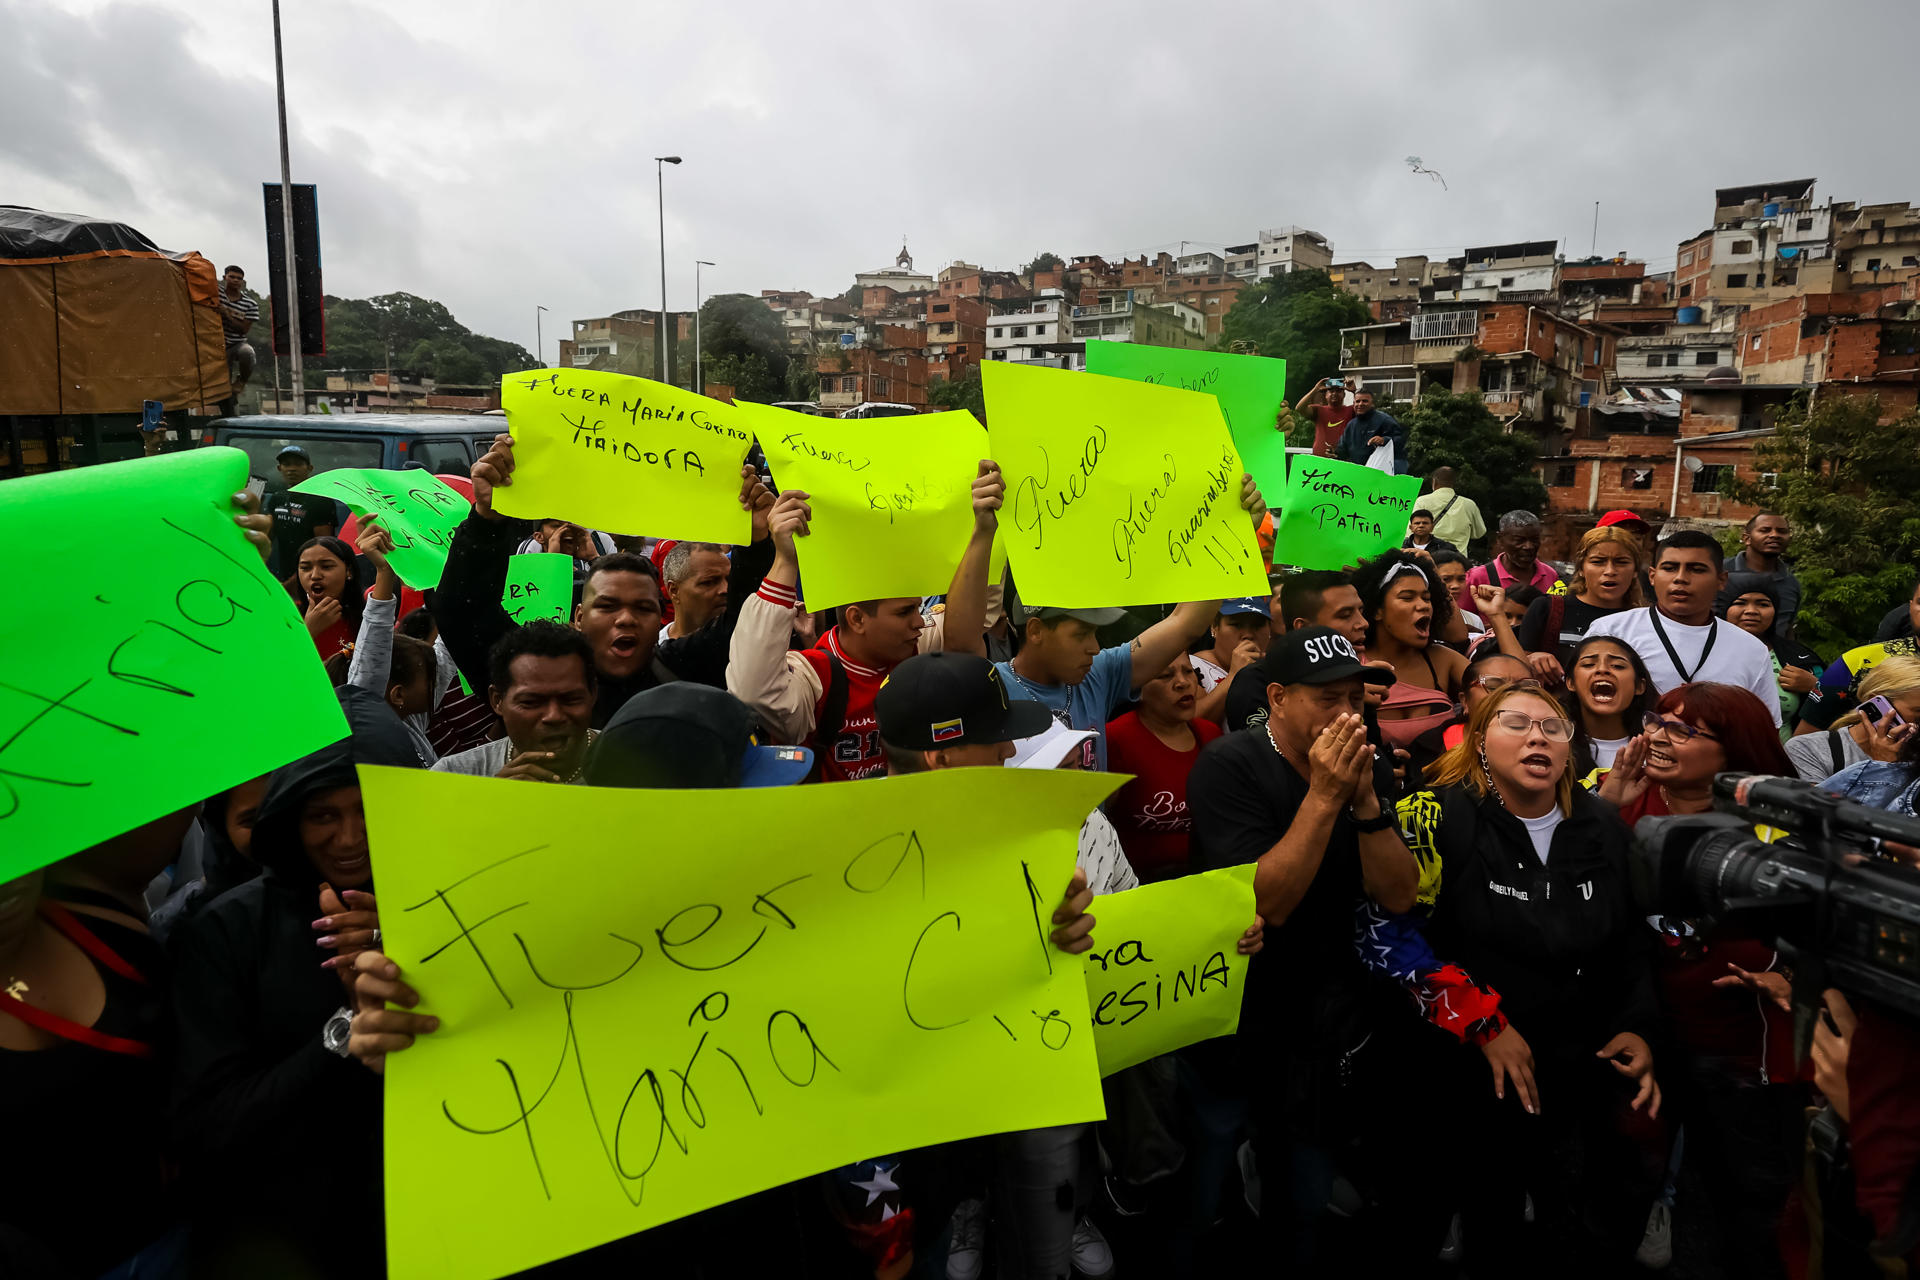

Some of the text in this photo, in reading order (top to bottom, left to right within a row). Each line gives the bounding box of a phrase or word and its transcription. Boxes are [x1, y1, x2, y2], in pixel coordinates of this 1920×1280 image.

[1015, 424, 1107, 550] Fuera
[1113, 453, 1177, 580] Fuera
[834, 729, 882, 762] 21
[403, 830, 925, 1009] Fuera
[442, 991, 840, 1207] Maria
